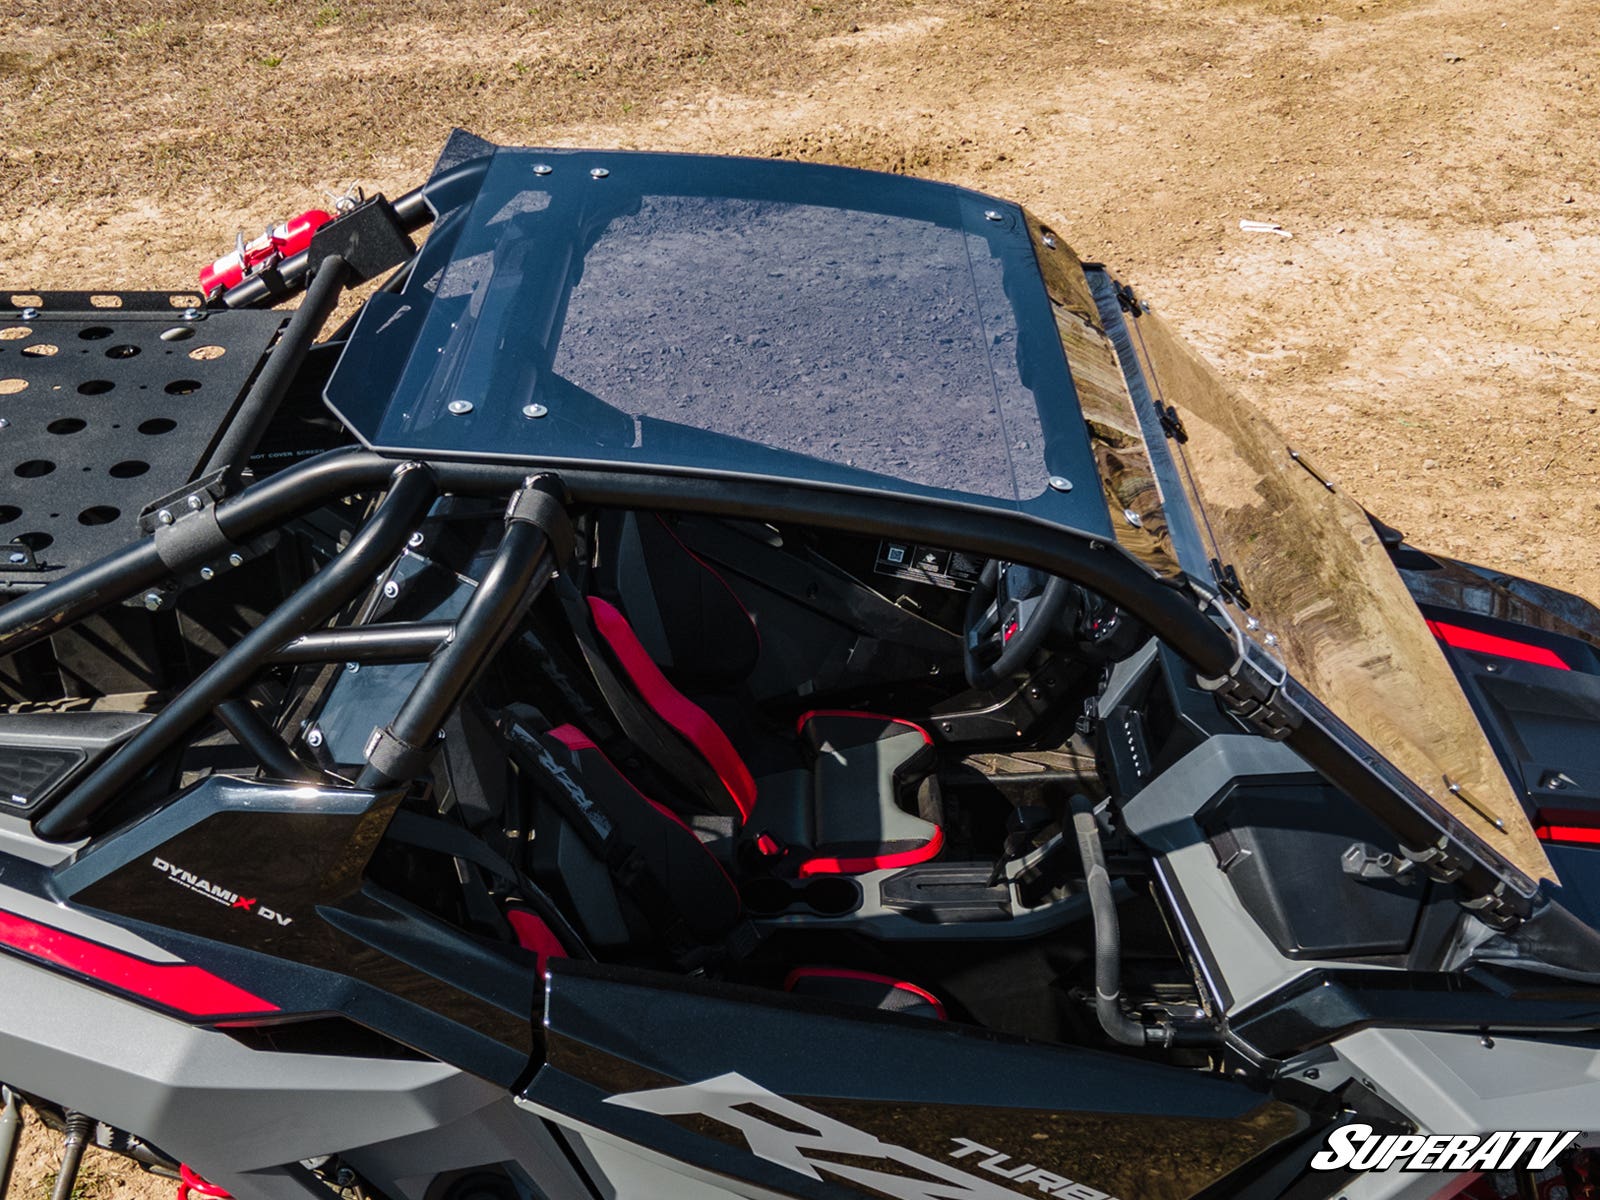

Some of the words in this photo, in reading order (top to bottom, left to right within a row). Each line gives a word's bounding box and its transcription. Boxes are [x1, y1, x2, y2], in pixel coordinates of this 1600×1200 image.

[267, 450, 294, 459] COVER
[152, 856, 257, 911] DYNAMIX
[257, 905, 293, 927] DV
[950, 1137, 1122, 1200] TURB
